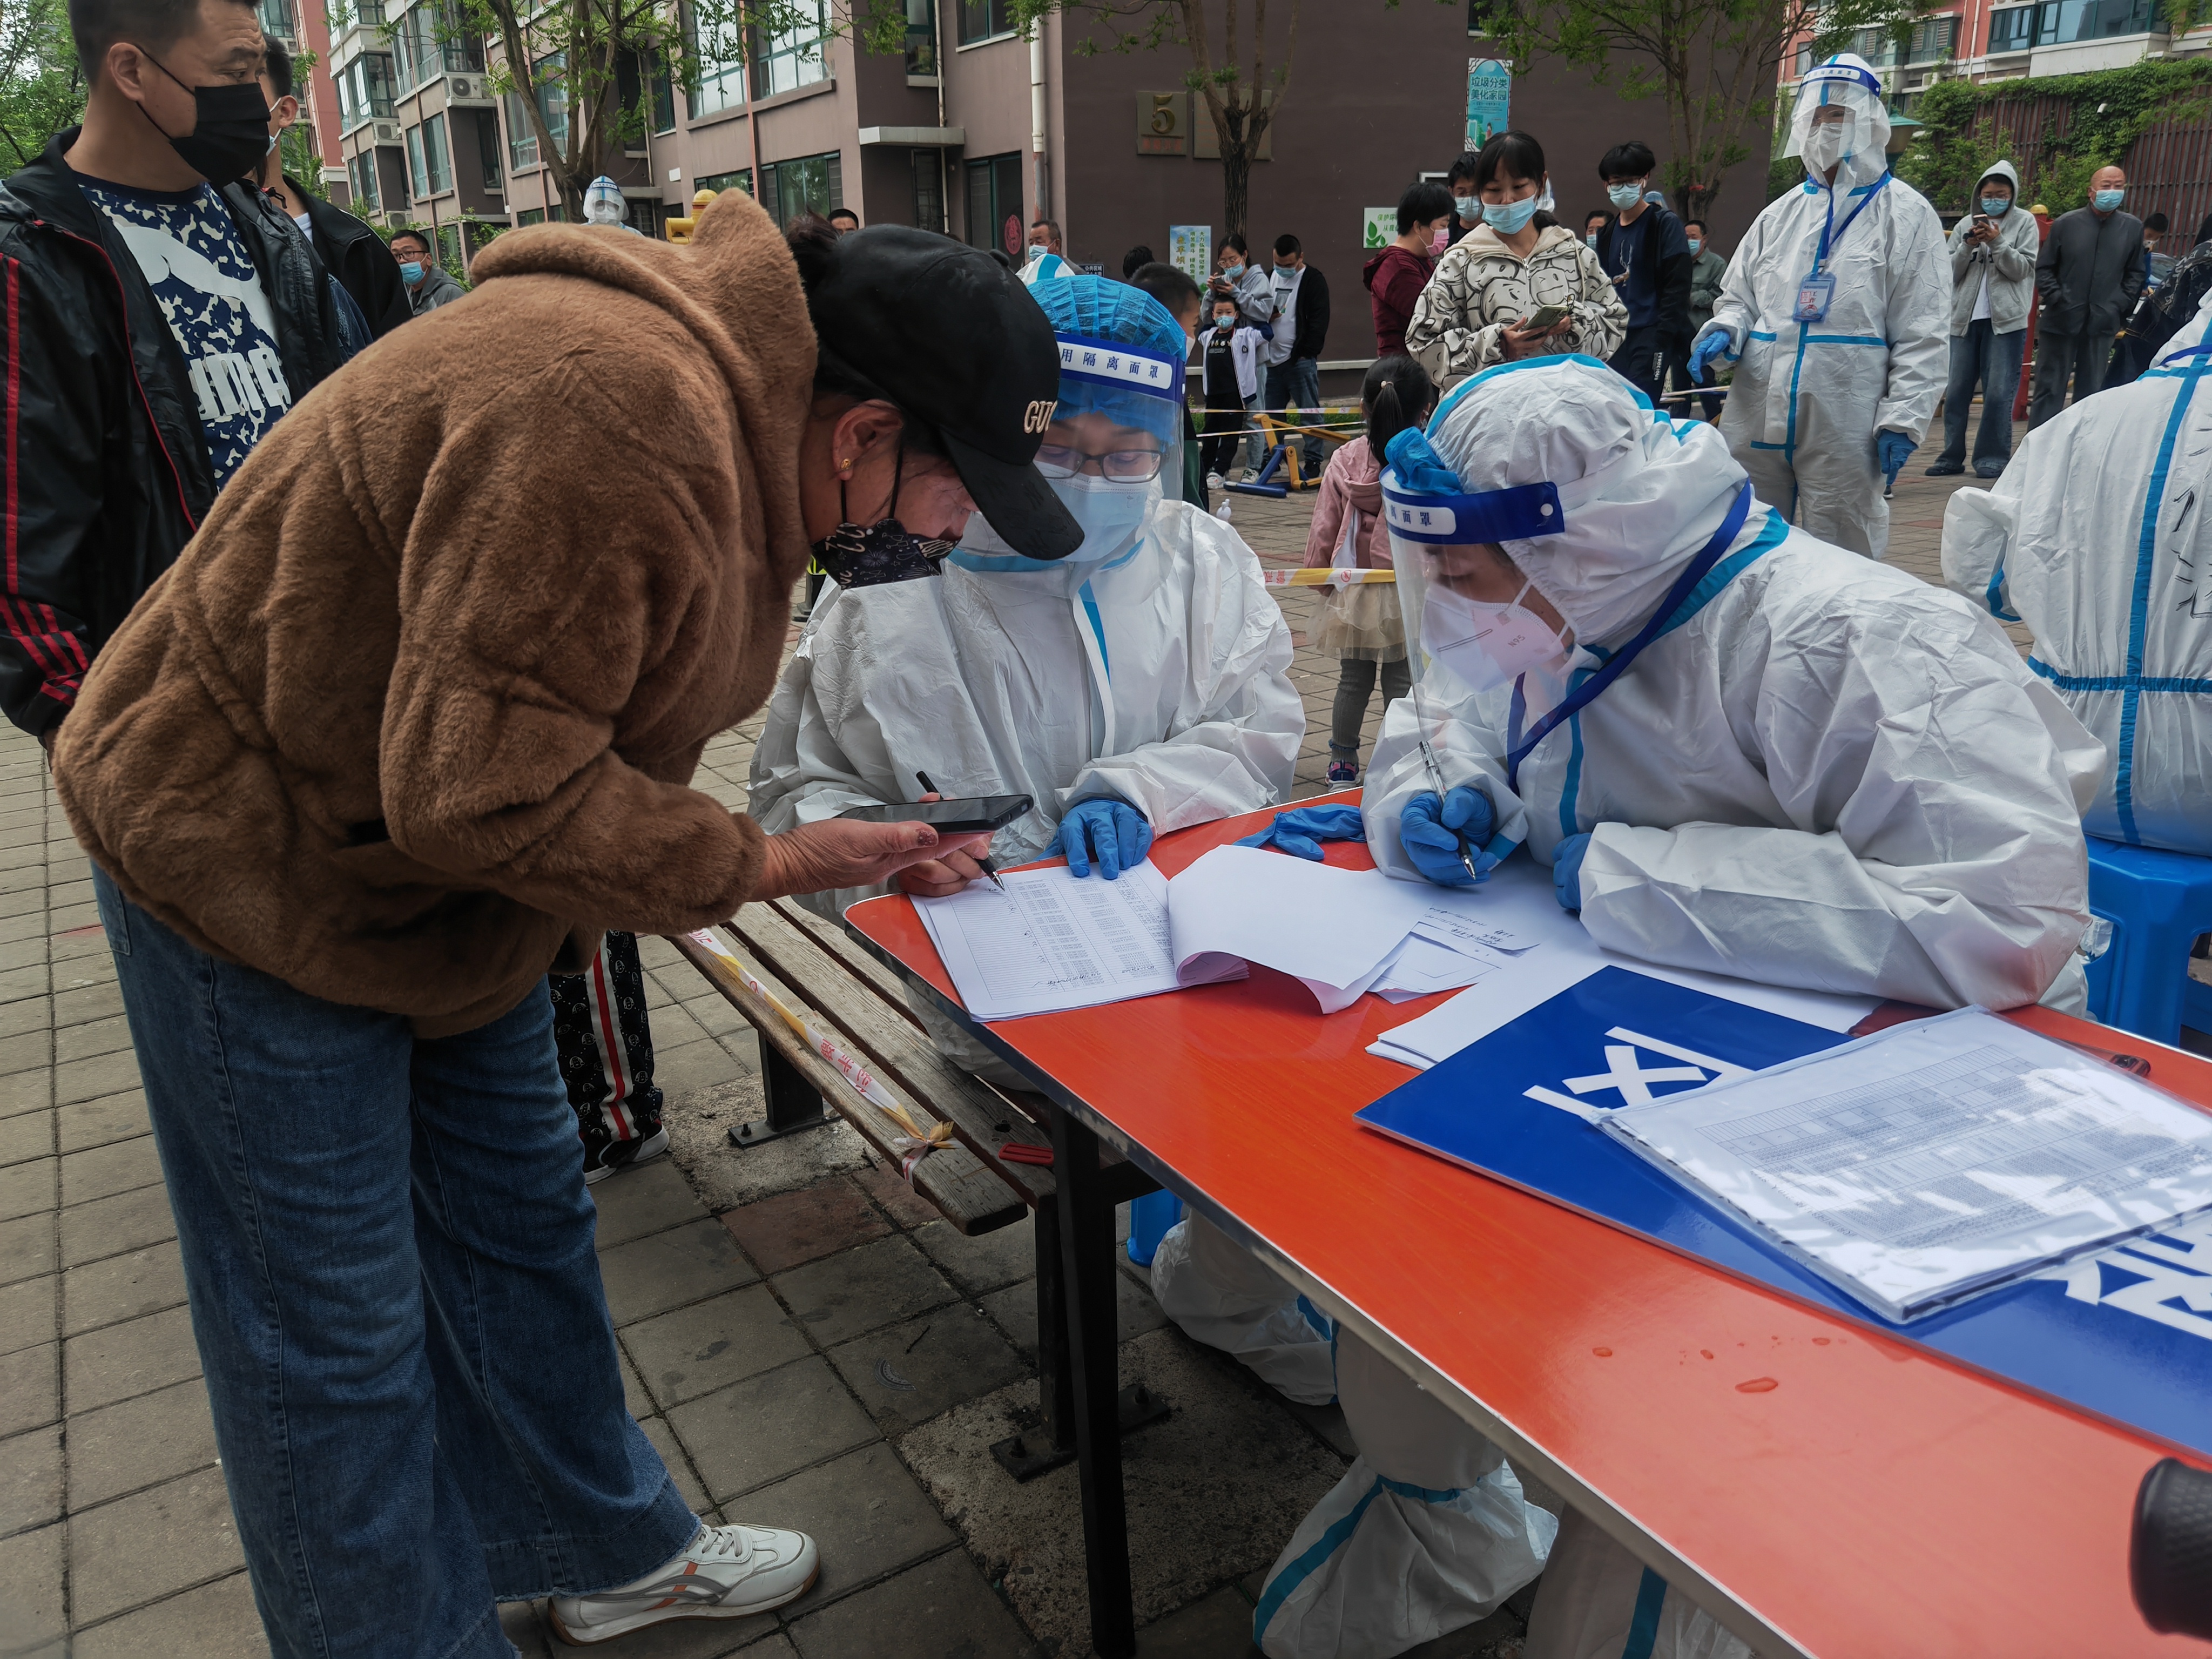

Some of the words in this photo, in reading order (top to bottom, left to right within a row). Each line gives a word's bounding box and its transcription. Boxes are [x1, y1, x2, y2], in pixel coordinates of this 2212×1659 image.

[1471, 76, 1507, 88] 垃圾分类
[1471, 89, 1506, 101] 美化家园
[1151, 93, 1175, 134] 5
[1061, 348, 1159, 379] 用隔离面罩
[1508, 635, 1525, 648] N95
